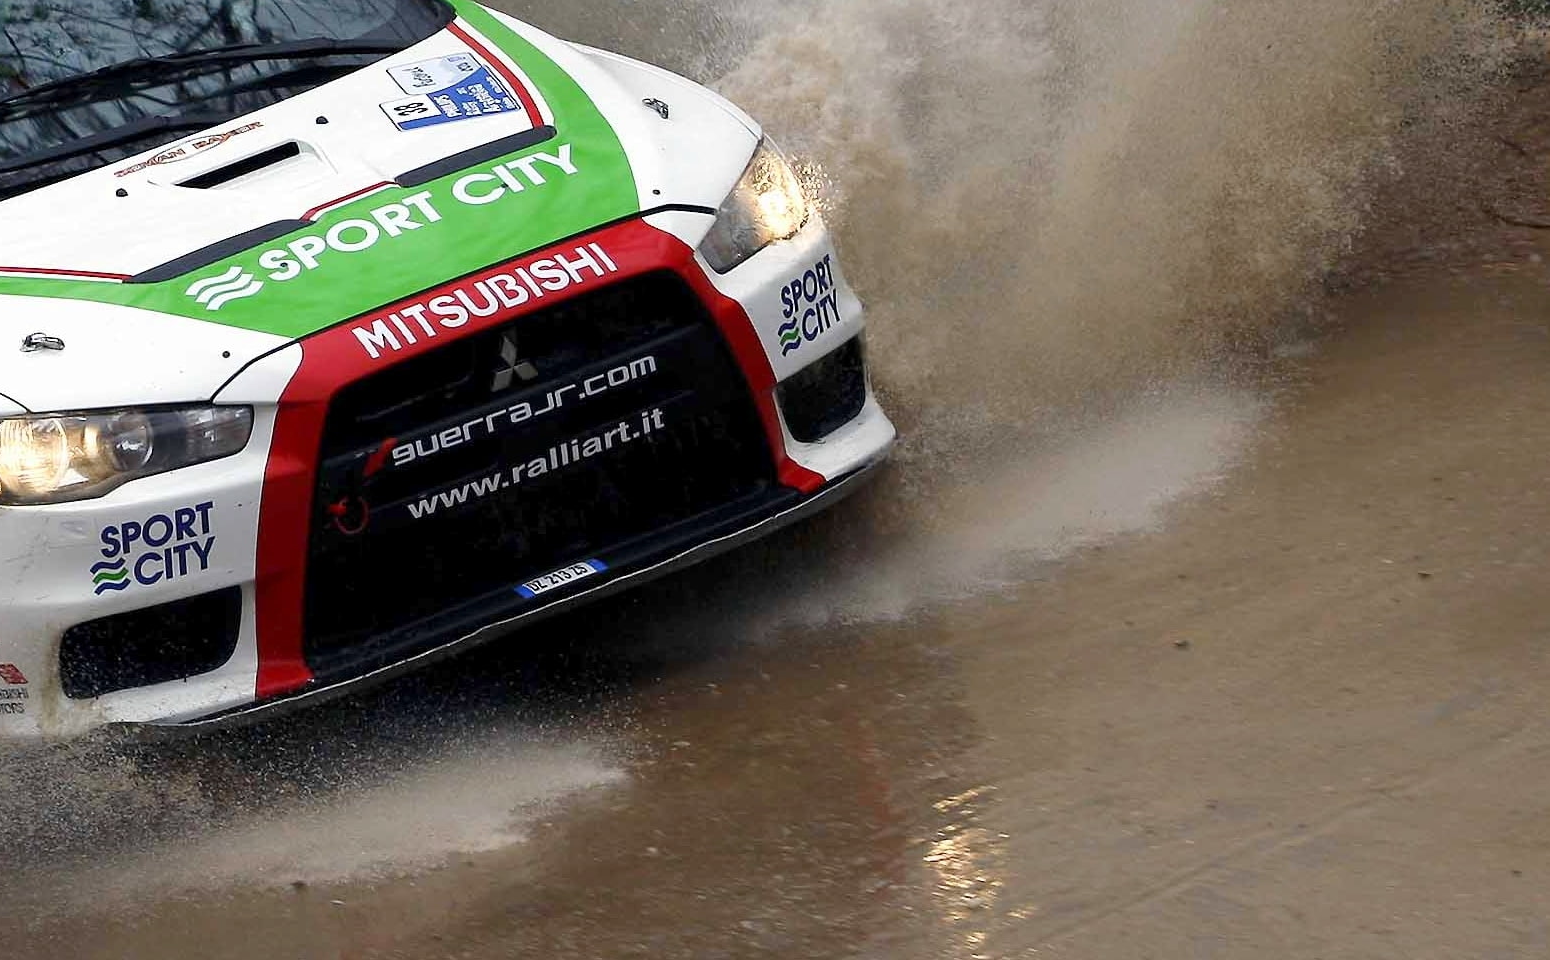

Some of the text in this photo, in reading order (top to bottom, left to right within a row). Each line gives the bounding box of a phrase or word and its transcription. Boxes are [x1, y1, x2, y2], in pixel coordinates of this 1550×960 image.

[393, 102, 429, 117] 38
[258, 143, 580, 282] SPORT CITY
[351, 242, 618, 359] MITSUBISHI
[780, 253, 834, 319] SPORT
[801, 288, 841, 342] CITY
[407, 406, 666, 519] www.ralliart.it
[100, 501, 214, 558] SPORT
[133, 536, 216, 586] CITY
[546, 570, 572, 585] 213
